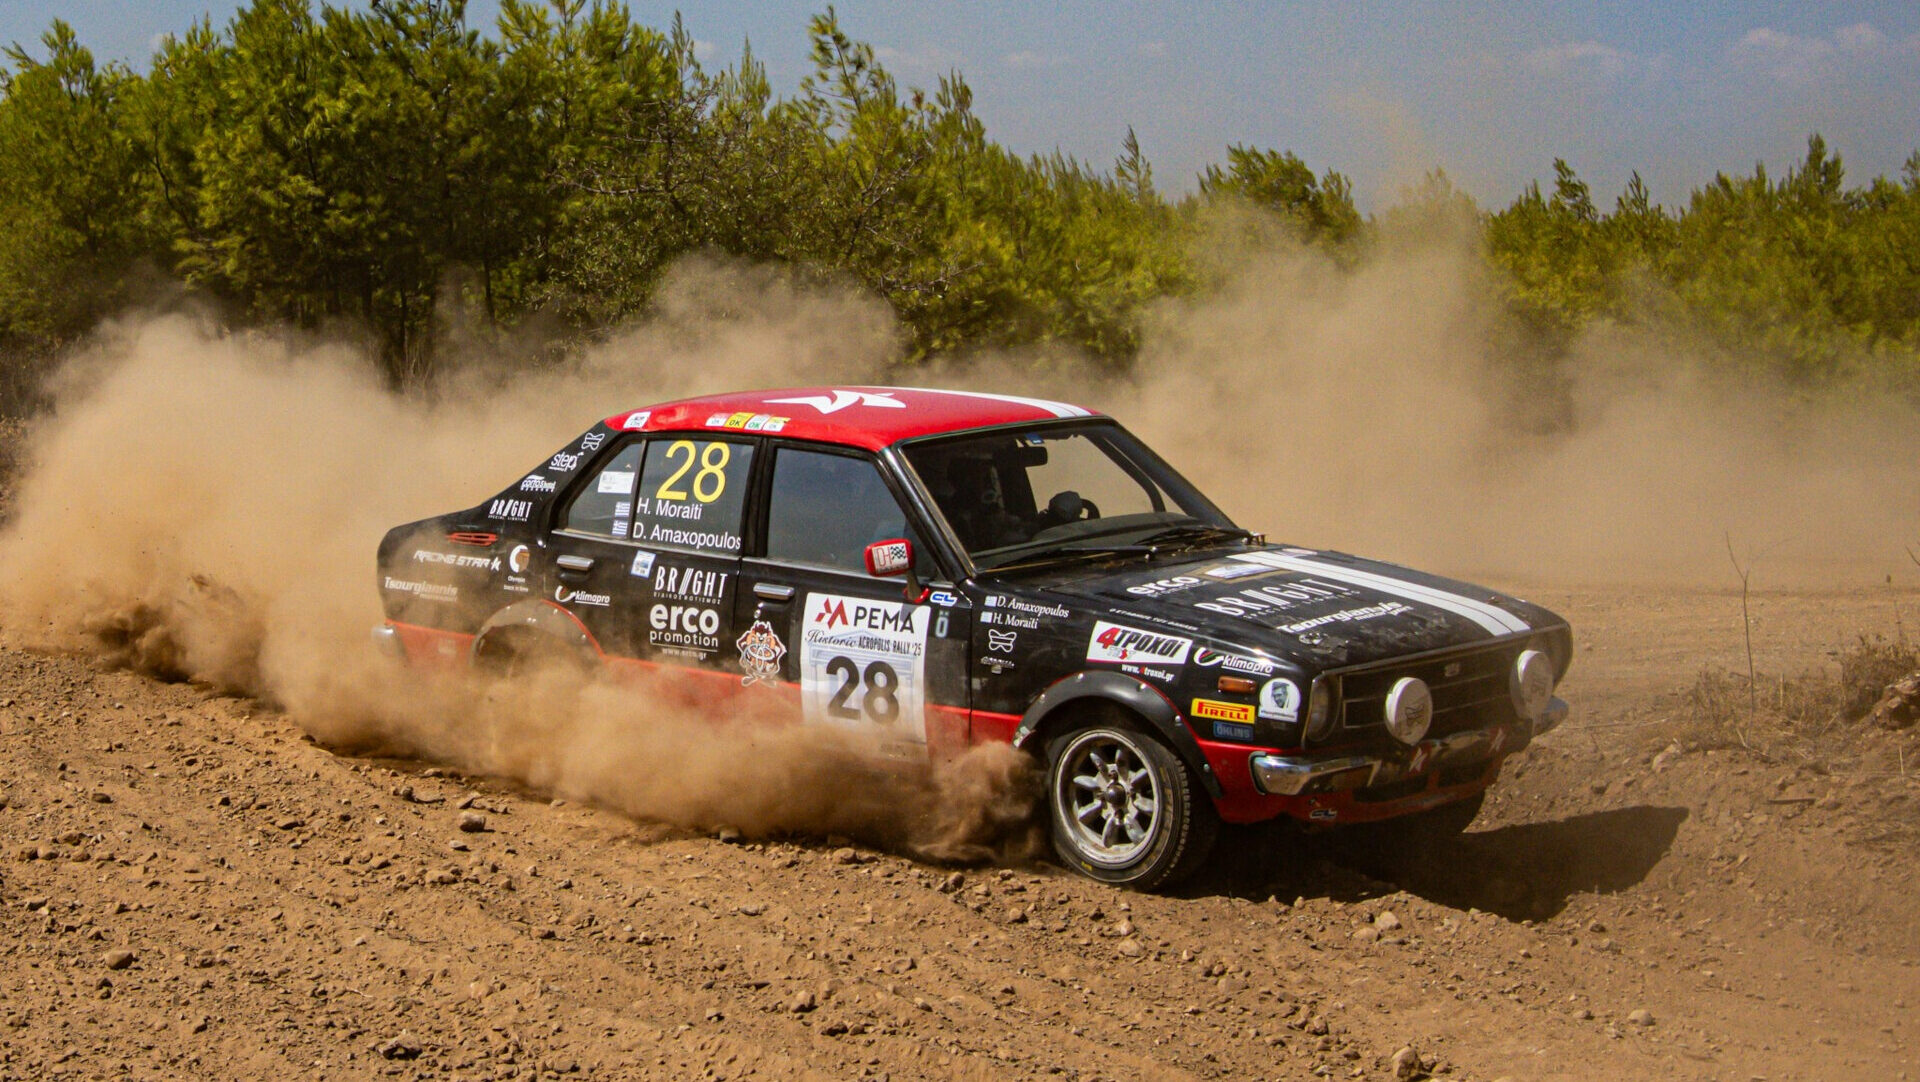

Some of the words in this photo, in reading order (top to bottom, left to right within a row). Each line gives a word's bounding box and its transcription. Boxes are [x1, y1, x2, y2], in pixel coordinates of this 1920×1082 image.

[729, 419, 741, 427] OK
[656, 440, 730, 503] 28
[490, 498, 532, 518] BRIGHT
[637, 498, 650, 514] H.
[656, 500, 702, 520] Moraiti
[633, 522, 646, 538] D.
[650, 524, 741, 550] Amaxopoulos
[456, 556, 491, 568] STAR
[654, 566, 728, 598] BRIGHT
[1126, 576, 1200, 594] erco
[576, 590, 610, 604] klimapro
[997, 596, 1006, 608] D.
[1008, 598, 1070, 618] Amaxopoulos
[1194, 578, 1349, 616] BRIGHT
[650, 604, 720, 635] erco
[854, 606, 914, 634] PEMA
[993, 612, 1002, 624] H.
[1005, 614, 1039, 629] Moraiti
[650, 630, 718, 647] promotion
[805, 629, 858, 647] Historic
[858, 636, 892, 653] ACROPOLIS
[892, 638, 910, 654] RALLY
[1122, 664, 1174, 682] www.4troxoi.gr
[1222, 655, 1273, 674] klimapro
[826, 656, 900, 724] 28
[1198, 701, 1248, 720] PIRELLI
